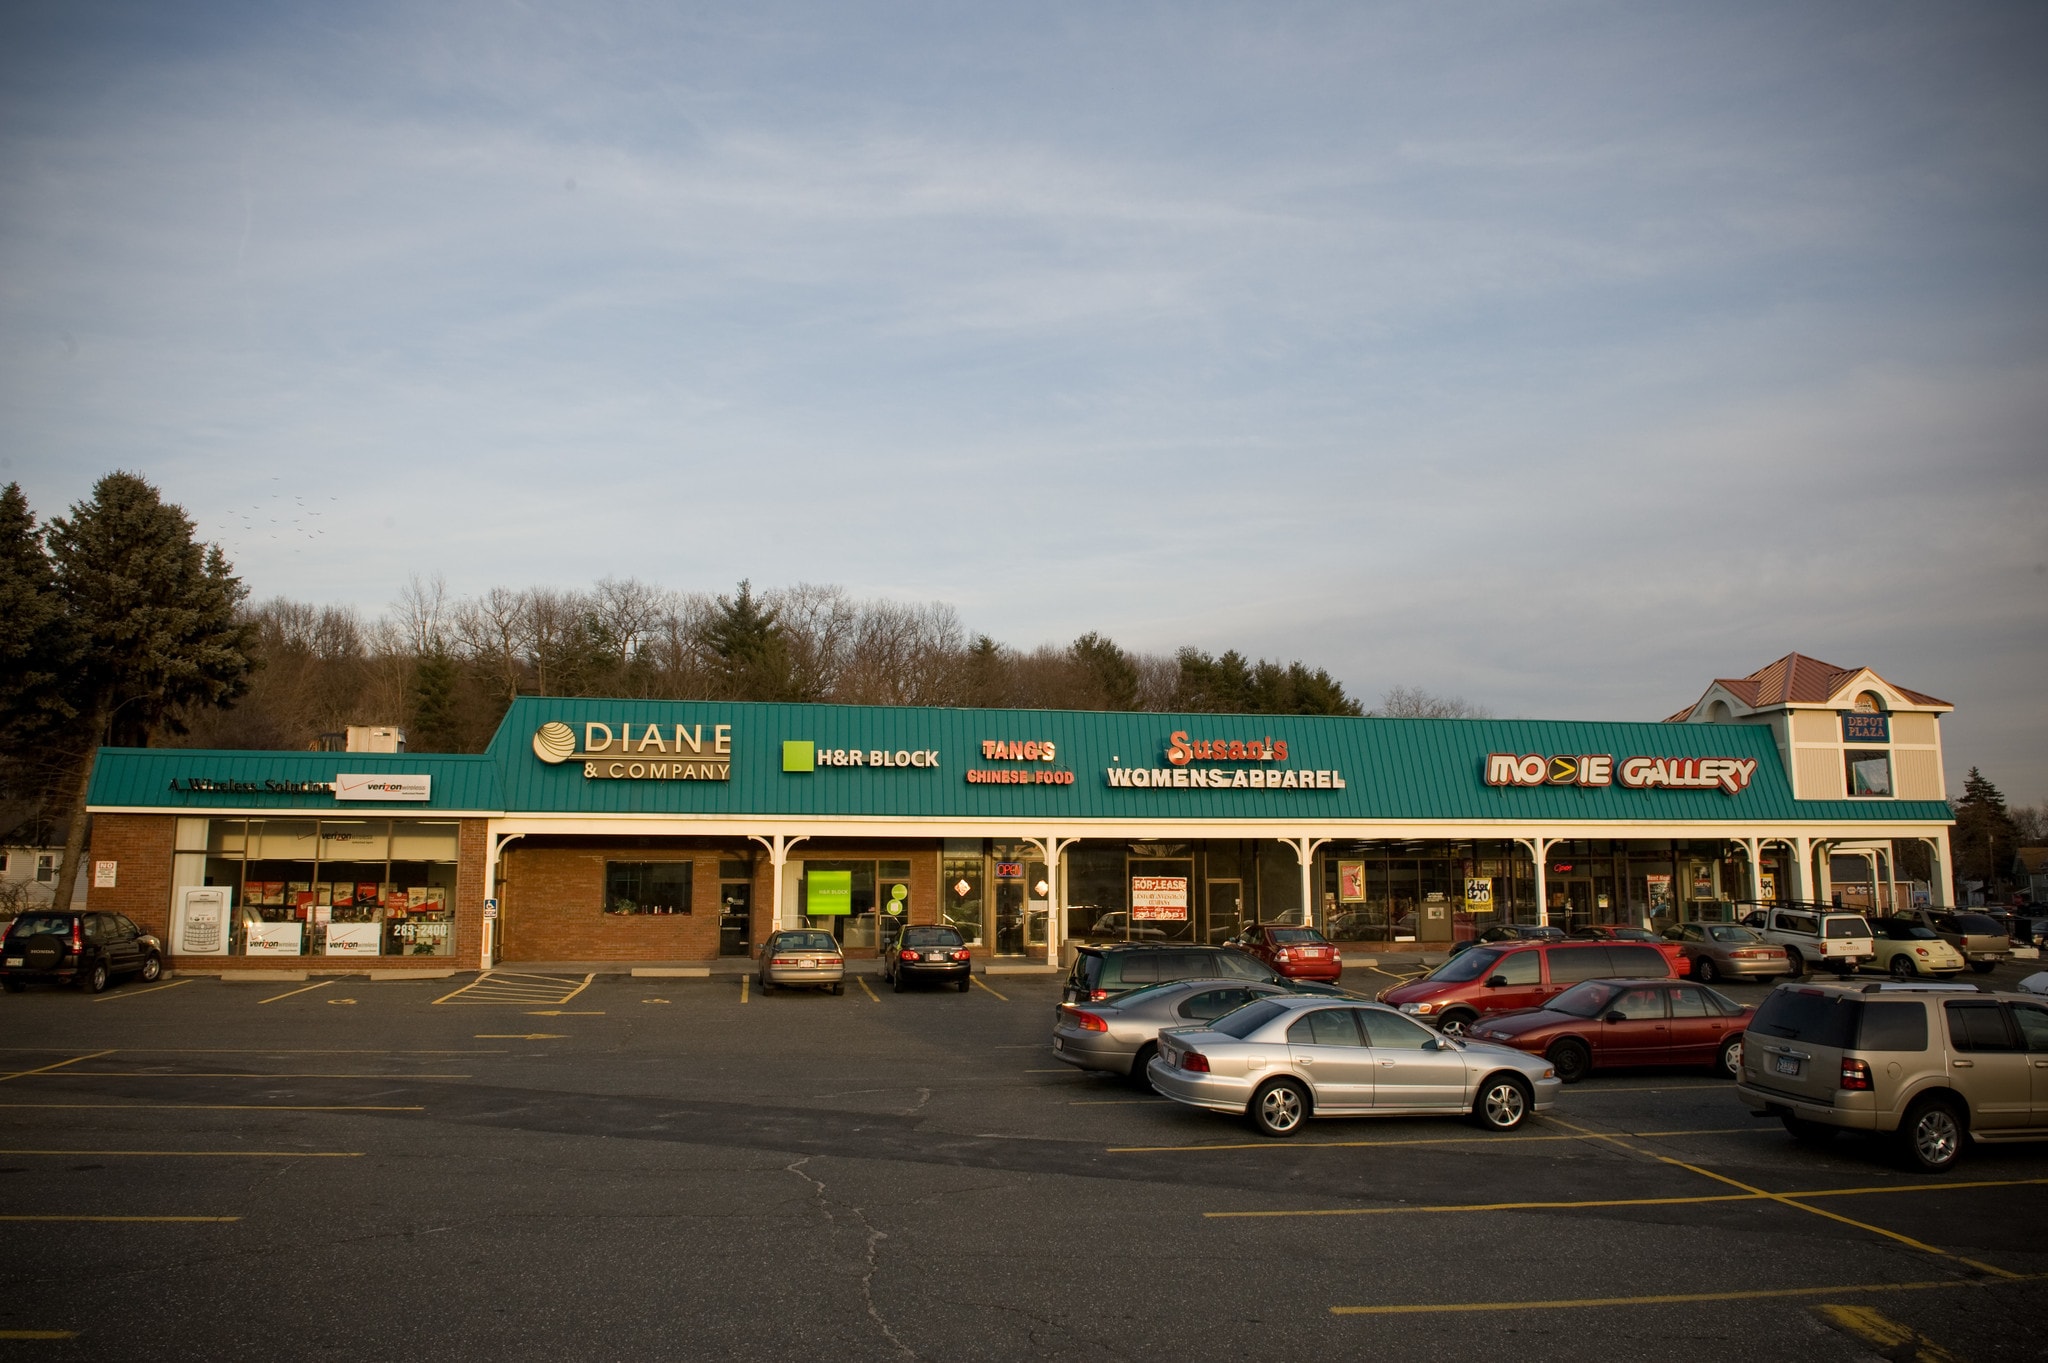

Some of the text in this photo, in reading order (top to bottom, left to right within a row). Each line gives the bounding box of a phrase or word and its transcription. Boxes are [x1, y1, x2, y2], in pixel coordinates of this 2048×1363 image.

[1847, 716, 1885, 727] DEPOT
[585, 722, 732, 754] DIANE
[1848, 726, 1886, 737] PLAZA
[982, 740, 1056, 761] TANG'S
[1168, 730, 1288, 766] Susan's
[817, 749, 940, 767] H&R BLOCK
[583, 762, 731, 780] & COMPANY
[966, 769, 1075, 785] CHINESE FOOD
[1106, 767, 1346, 789] WOMENS APPAREL
[1620, 757, 1758, 793] GALLERY
[187, 778, 257, 792] Wireless
[264, 778, 332, 793] Solution
[997, 864, 1021, 877] OPEN
[1134, 879, 1153, 890] FOR
[1467, 879, 1489, 890] 2 for
